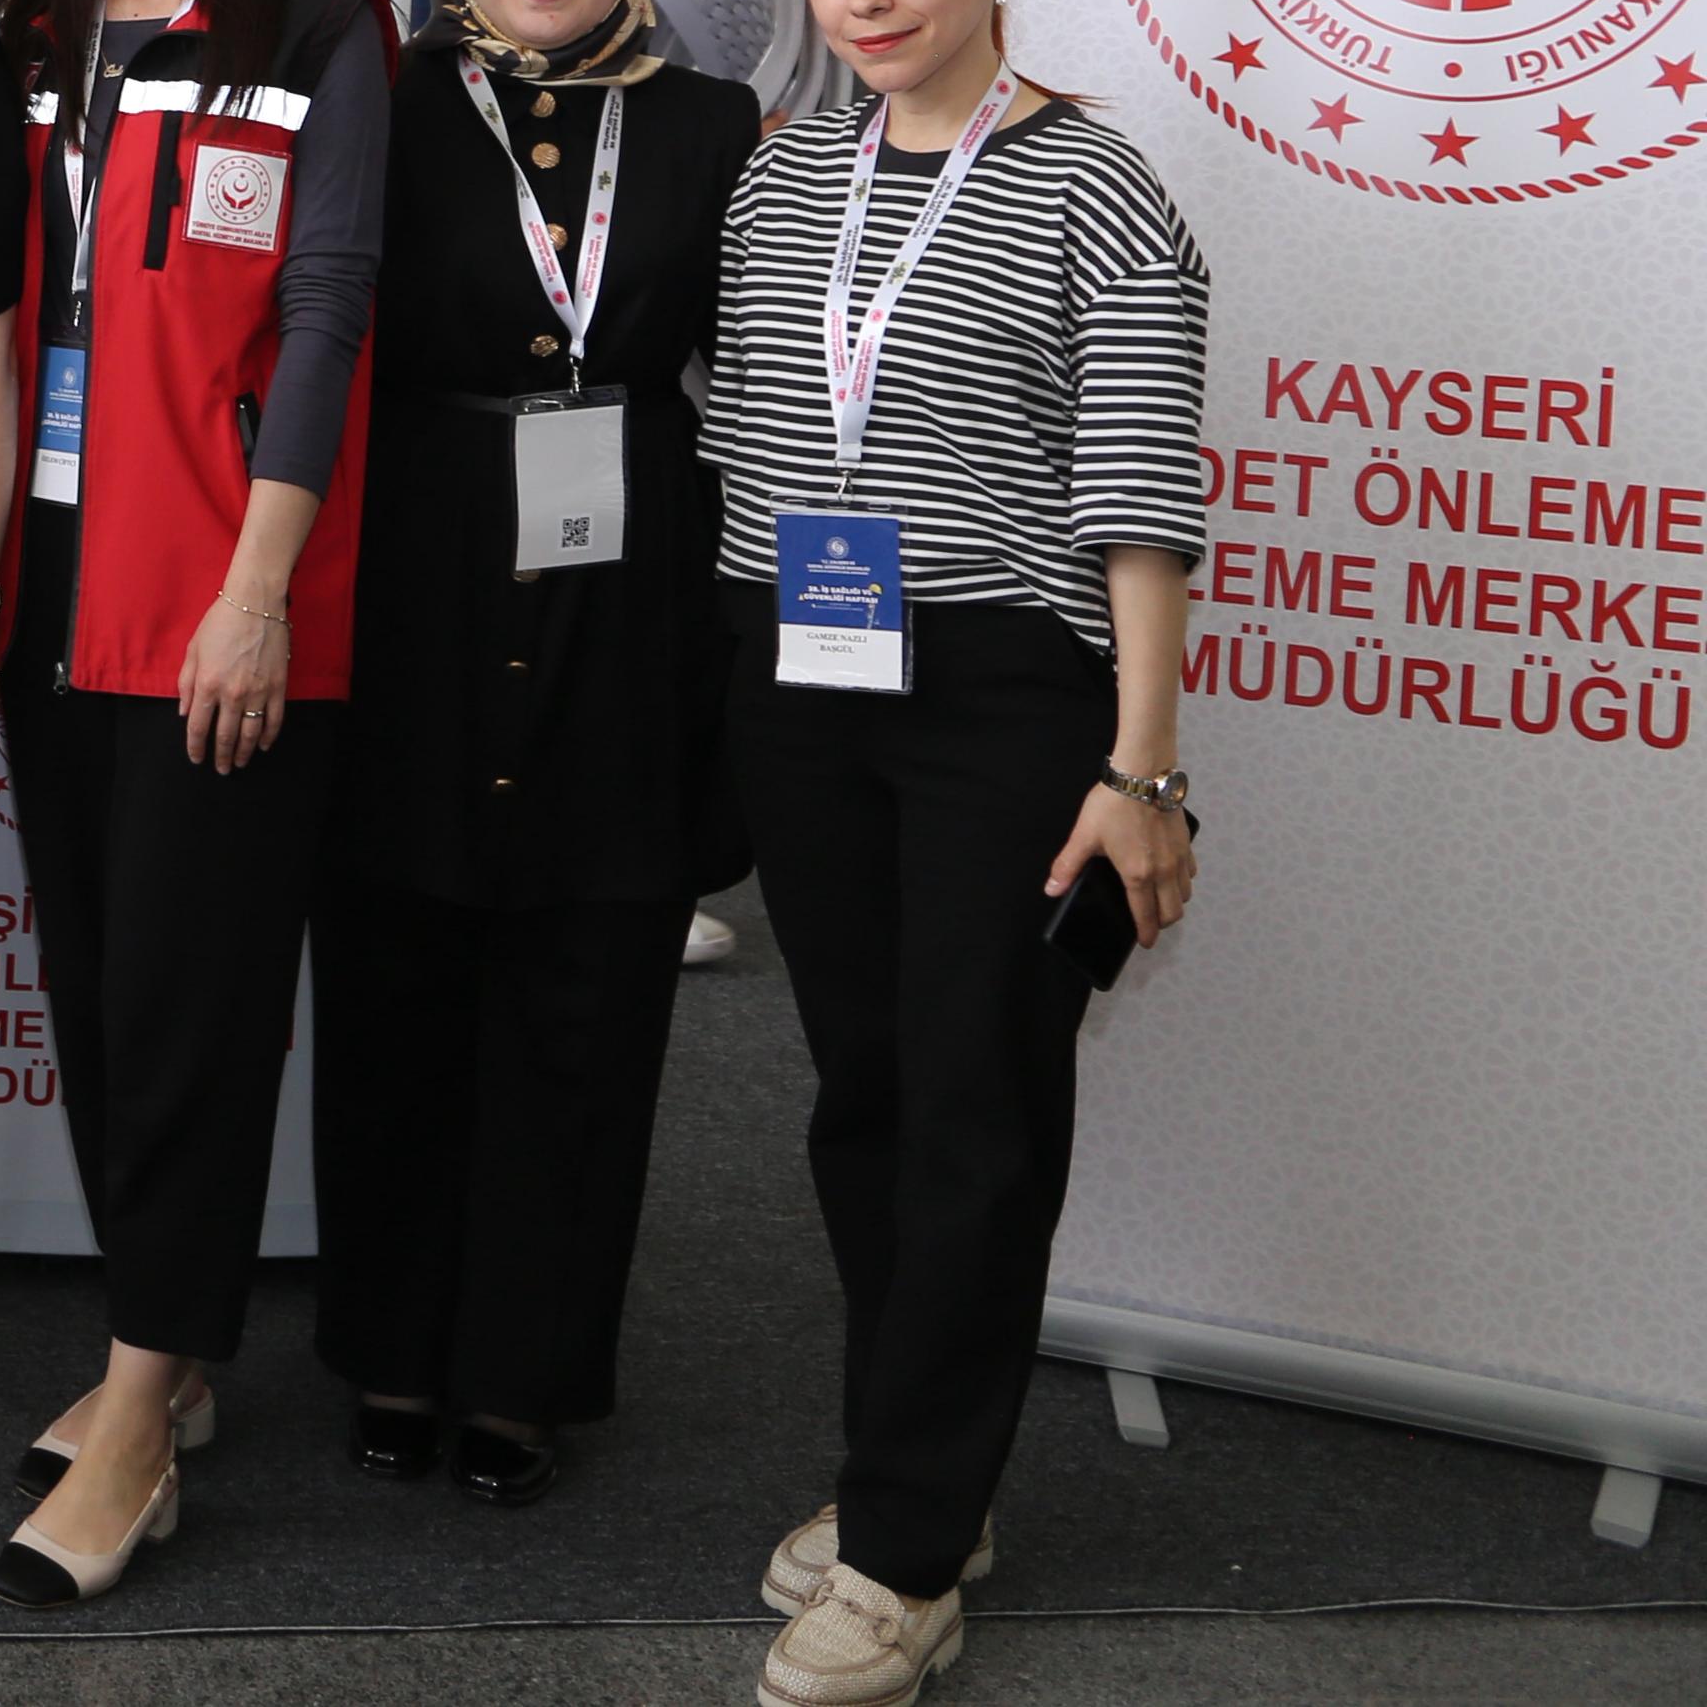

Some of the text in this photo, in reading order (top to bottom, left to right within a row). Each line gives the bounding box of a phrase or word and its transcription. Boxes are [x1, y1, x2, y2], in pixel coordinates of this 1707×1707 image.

[1264, 356, 1615, 448] KAYSERİ
[1353, 446, 1707, 556] ÖNLEME
[807, 631, 867, 643] GAMZE NAZLI
[1405, 562, 1707, 655] MERKE
[1182, 623, 1692, 750] MÜDÜRLÜĞÜ
